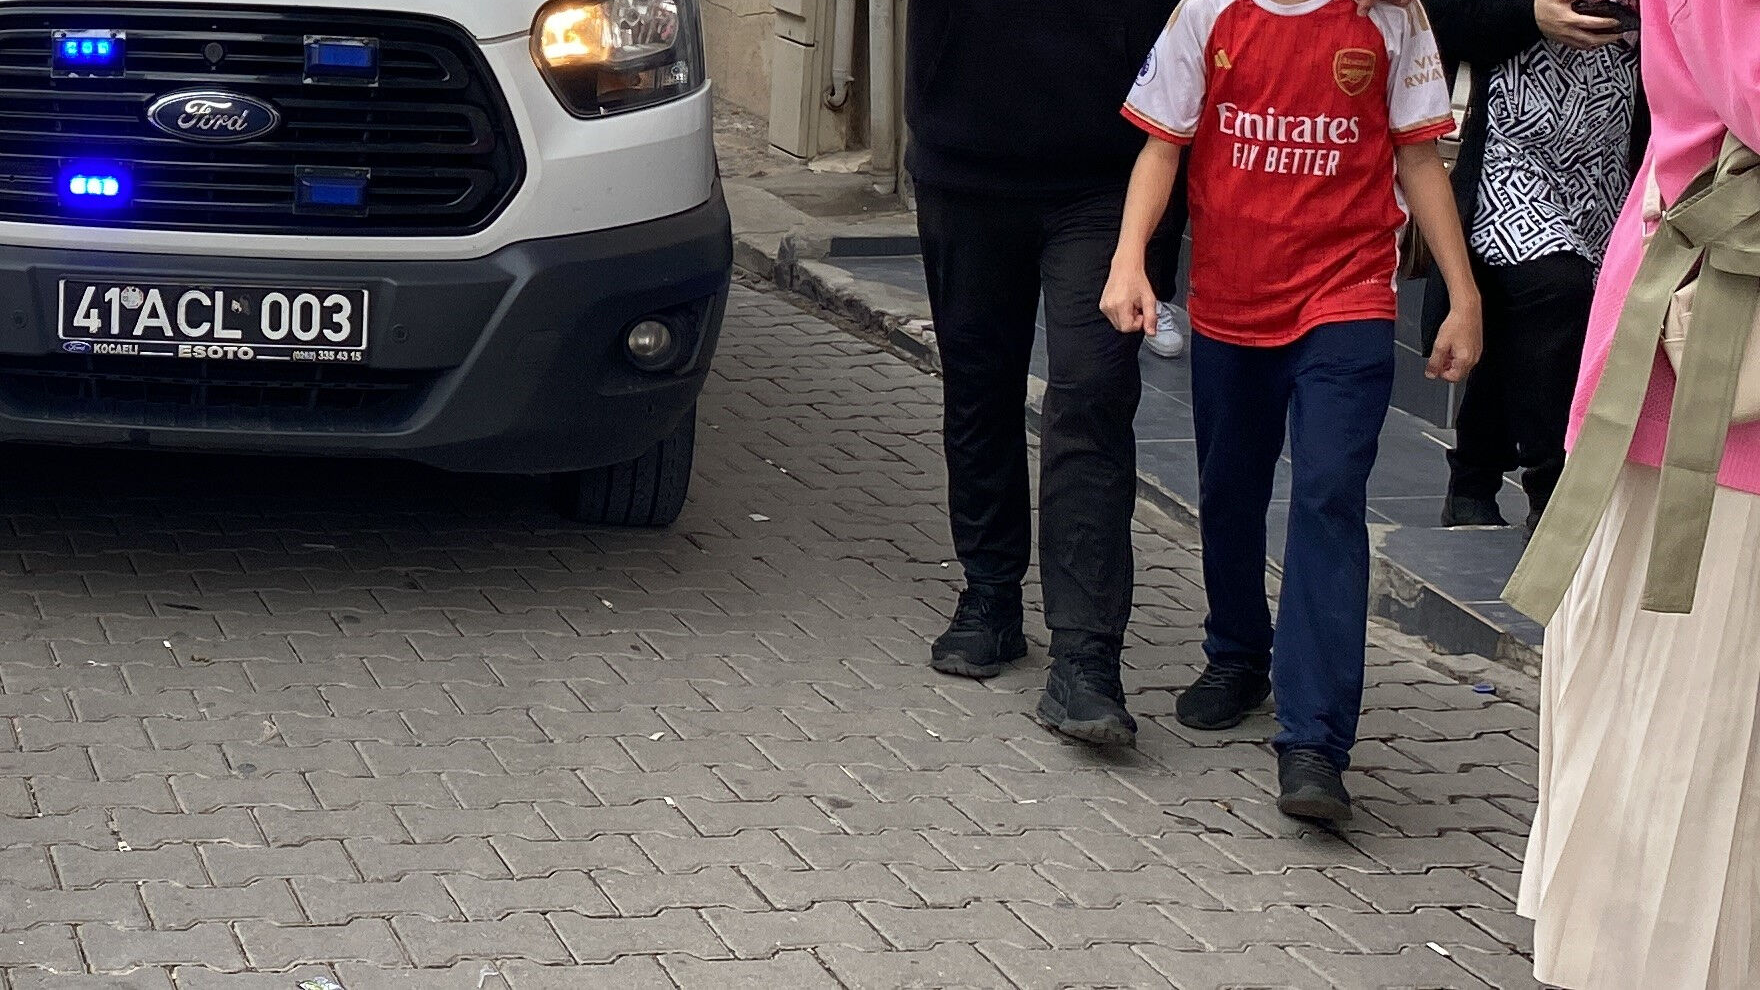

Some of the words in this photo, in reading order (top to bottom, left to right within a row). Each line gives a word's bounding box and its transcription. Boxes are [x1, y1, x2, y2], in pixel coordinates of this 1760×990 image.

[177, 100, 249, 131] Ford
[1216, 102, 1360, 144] Emirates
[1232, 142, 1260, 171] FLY
[1264, 146, 1341, 177] BETTER
[73, 286, 121, 335] 41
[132, 288, 243, 339] ACL
[260, 292, 352, 342] 003
[178, 344, 255, 360] ESOTO
